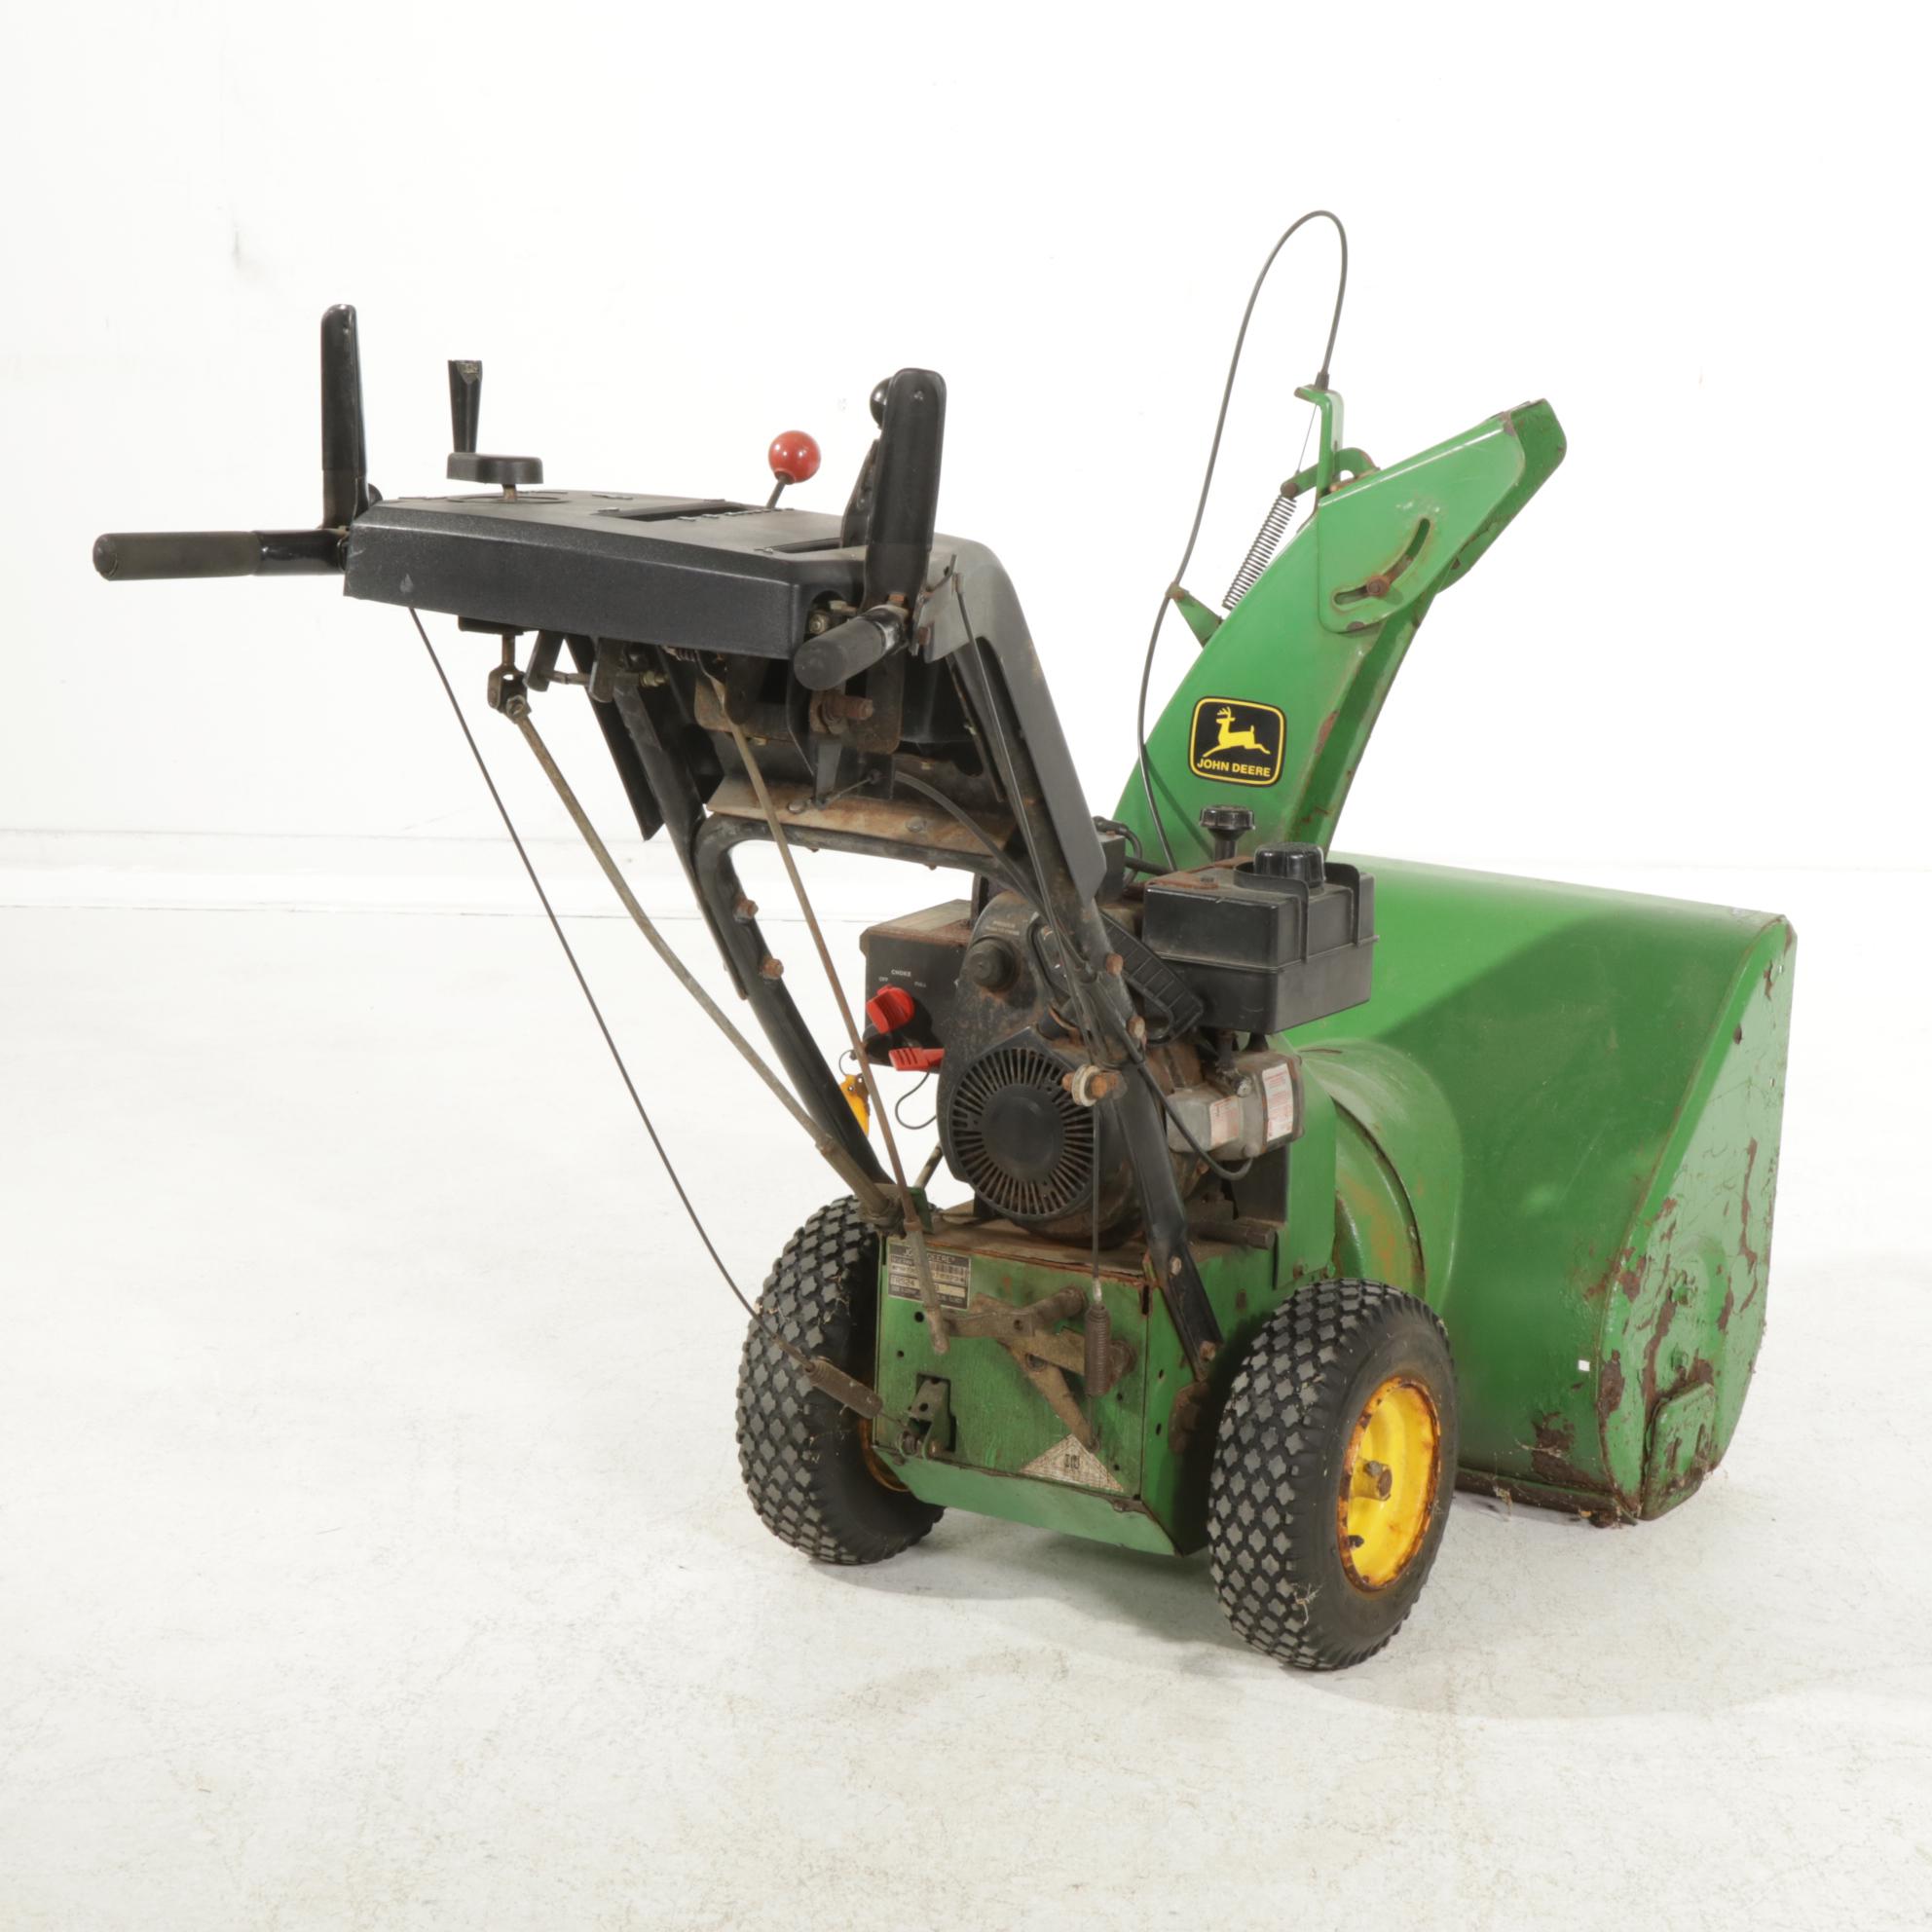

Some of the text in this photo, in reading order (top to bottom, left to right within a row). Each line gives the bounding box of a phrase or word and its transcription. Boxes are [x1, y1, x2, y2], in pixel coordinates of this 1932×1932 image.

[1197, 759, 1271, 777] JOHN DEERE
[890, 969, 911, 978] CHOKE
